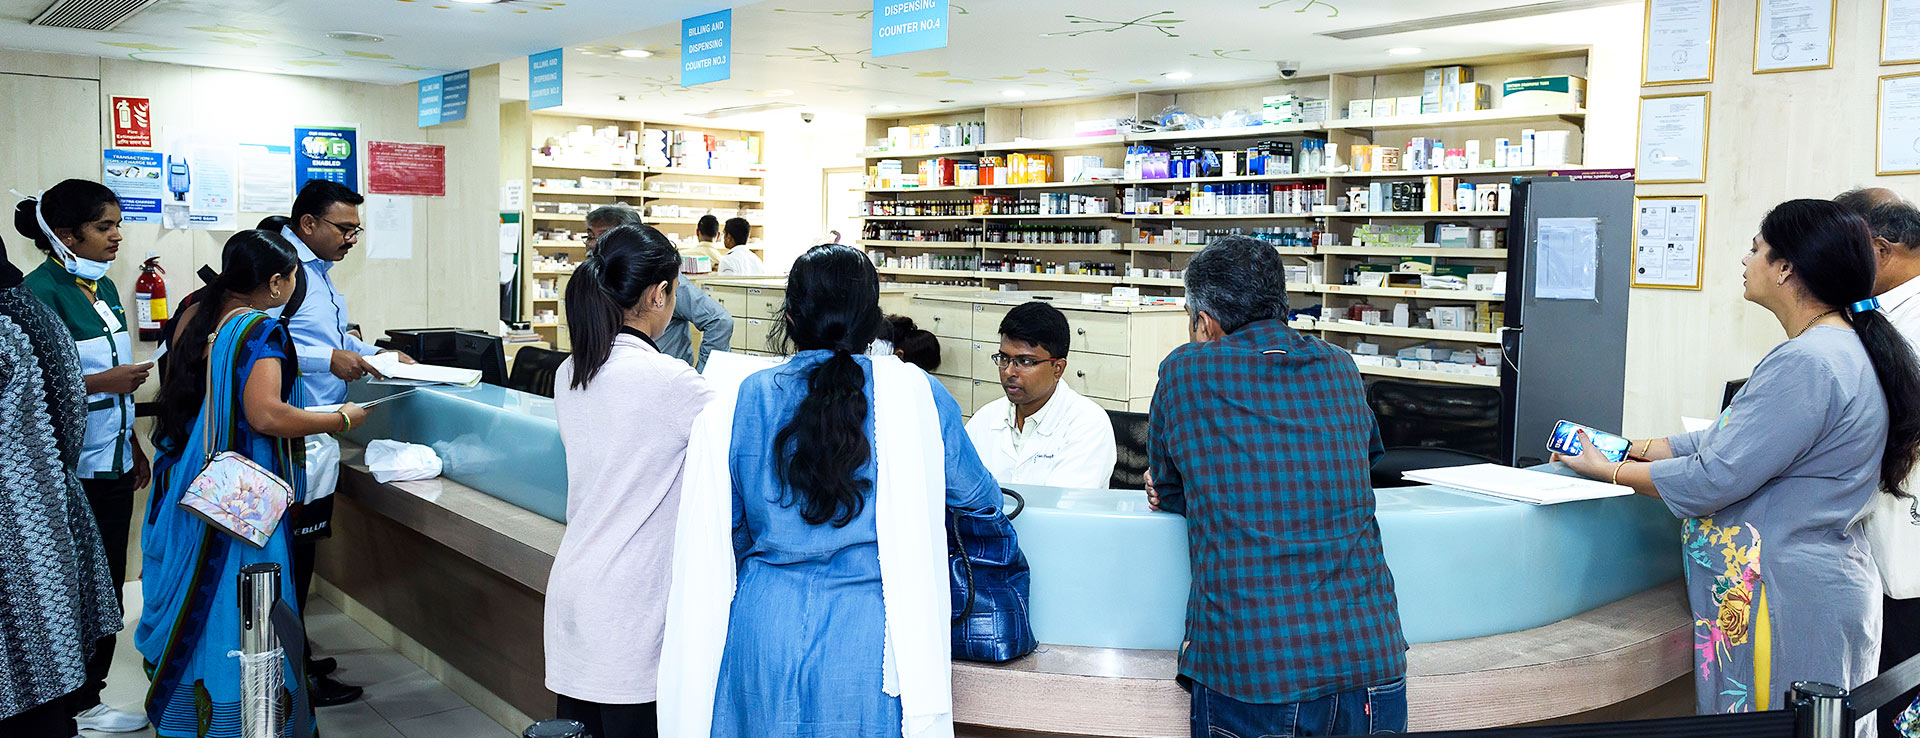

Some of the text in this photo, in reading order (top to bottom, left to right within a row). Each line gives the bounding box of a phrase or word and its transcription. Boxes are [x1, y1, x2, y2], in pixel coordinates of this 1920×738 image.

[884, 0, 936, 16] DISPENSING
[688, 21, 724, 36] BILLING AND
[879, 18, 940, 37] COUNTER NO.4
[688, 38, 723, 54] DISPENSING
[685, 55, 727, 71] COUNTER NO.3
